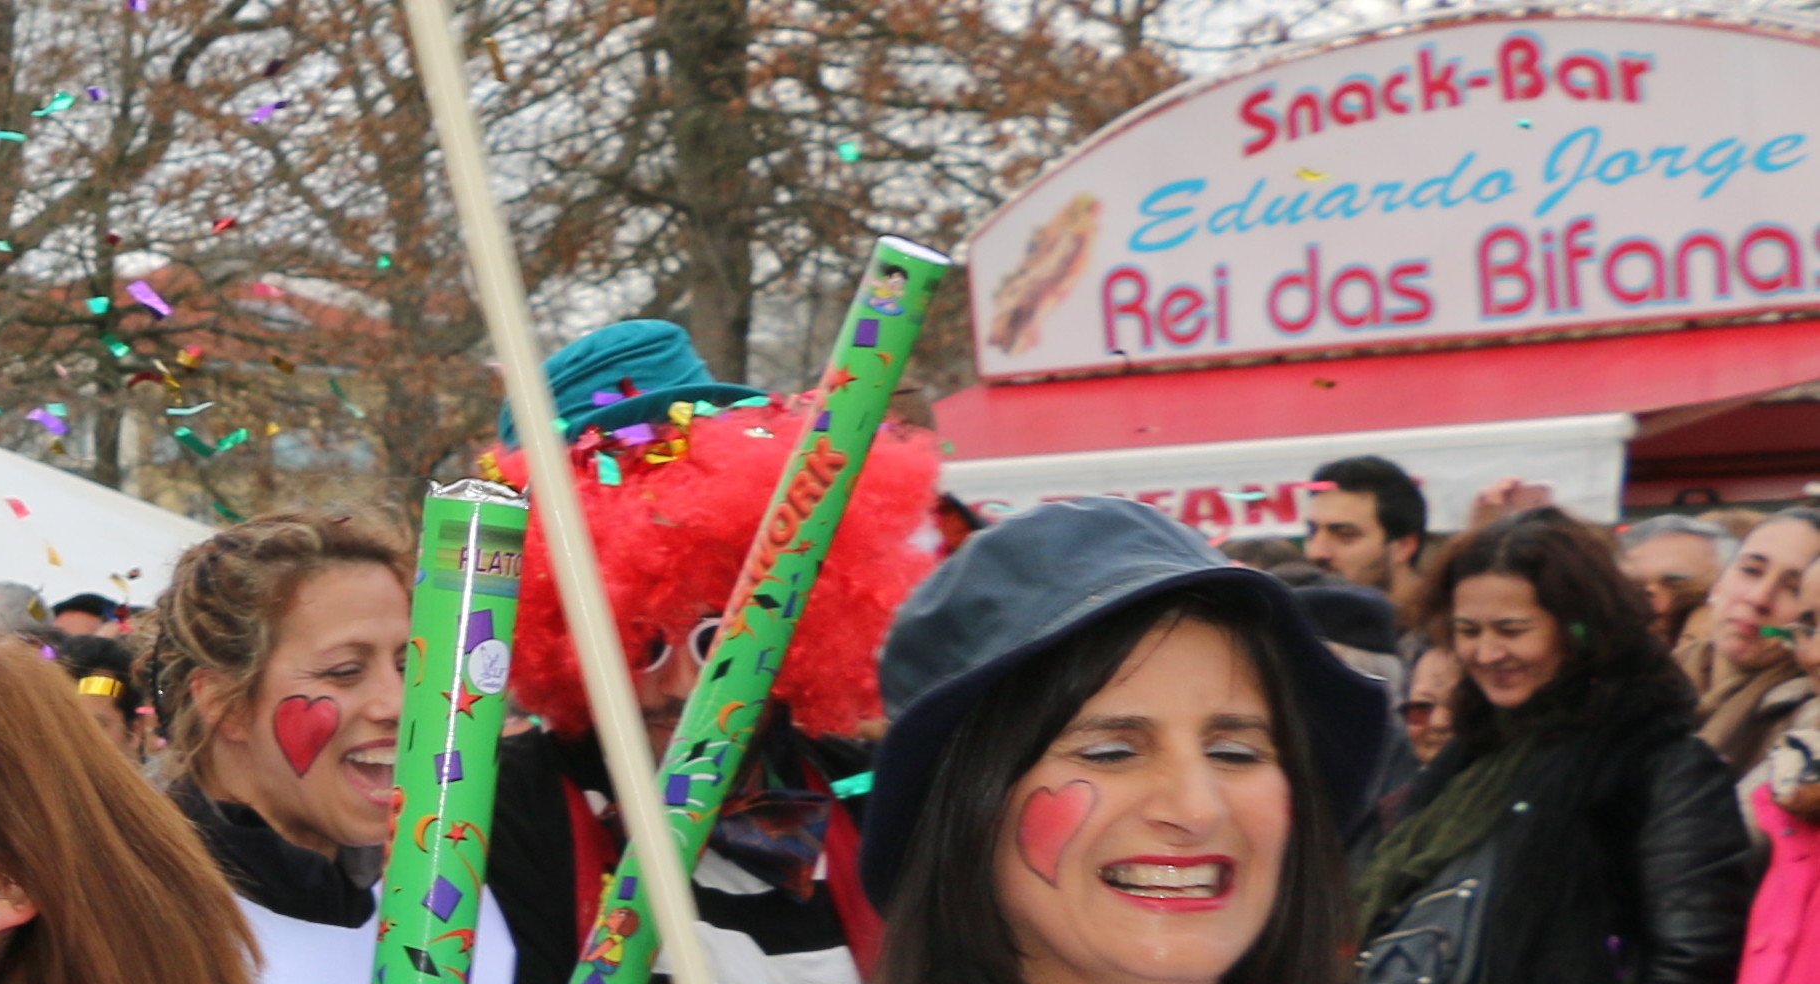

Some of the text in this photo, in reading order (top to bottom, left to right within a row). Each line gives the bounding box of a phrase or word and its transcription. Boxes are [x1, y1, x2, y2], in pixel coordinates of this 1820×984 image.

[1237, 30, 1657, 158] Snack-Bar
[1127, 125, 1809, 253] Eduardo Jorge
[1100, 262, 1231, 355] Rei
[1264, 242, 1437, 338] das
